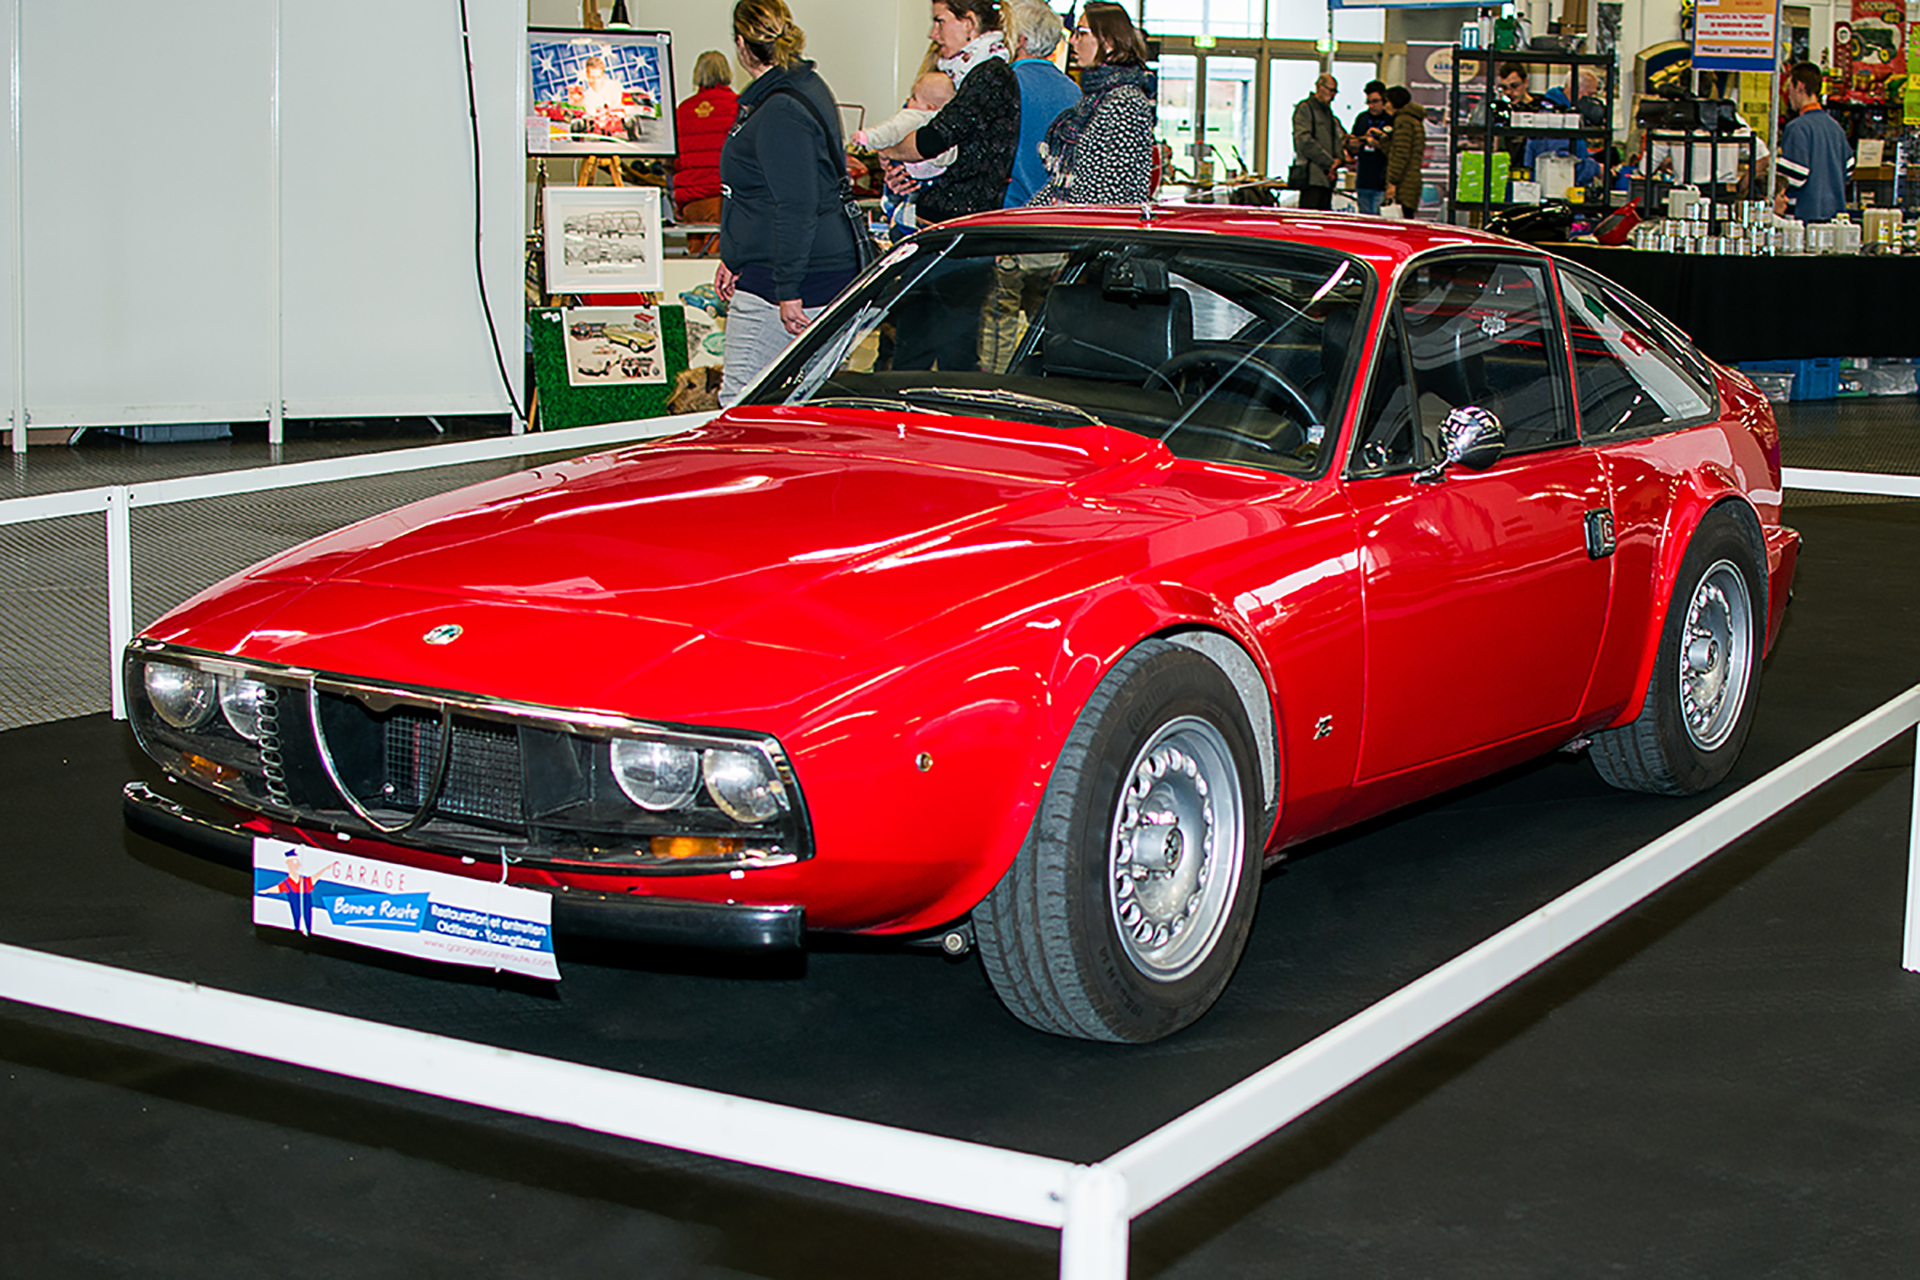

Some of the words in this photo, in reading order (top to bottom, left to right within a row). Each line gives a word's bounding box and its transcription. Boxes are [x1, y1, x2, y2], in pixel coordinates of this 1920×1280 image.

[332, 860, 406, 892] GARAGE
[334, 896, 376, 916] Bonne
[380, 900, 420, 919] Route
[431, 904, 488, 925] Restauration
[489, 917, 501, 928] et
[502, 920, 547, 936] entretien
[436, 920, 478, 938] Oldtimer
[484, 929, 541, 948] Youngtimer
